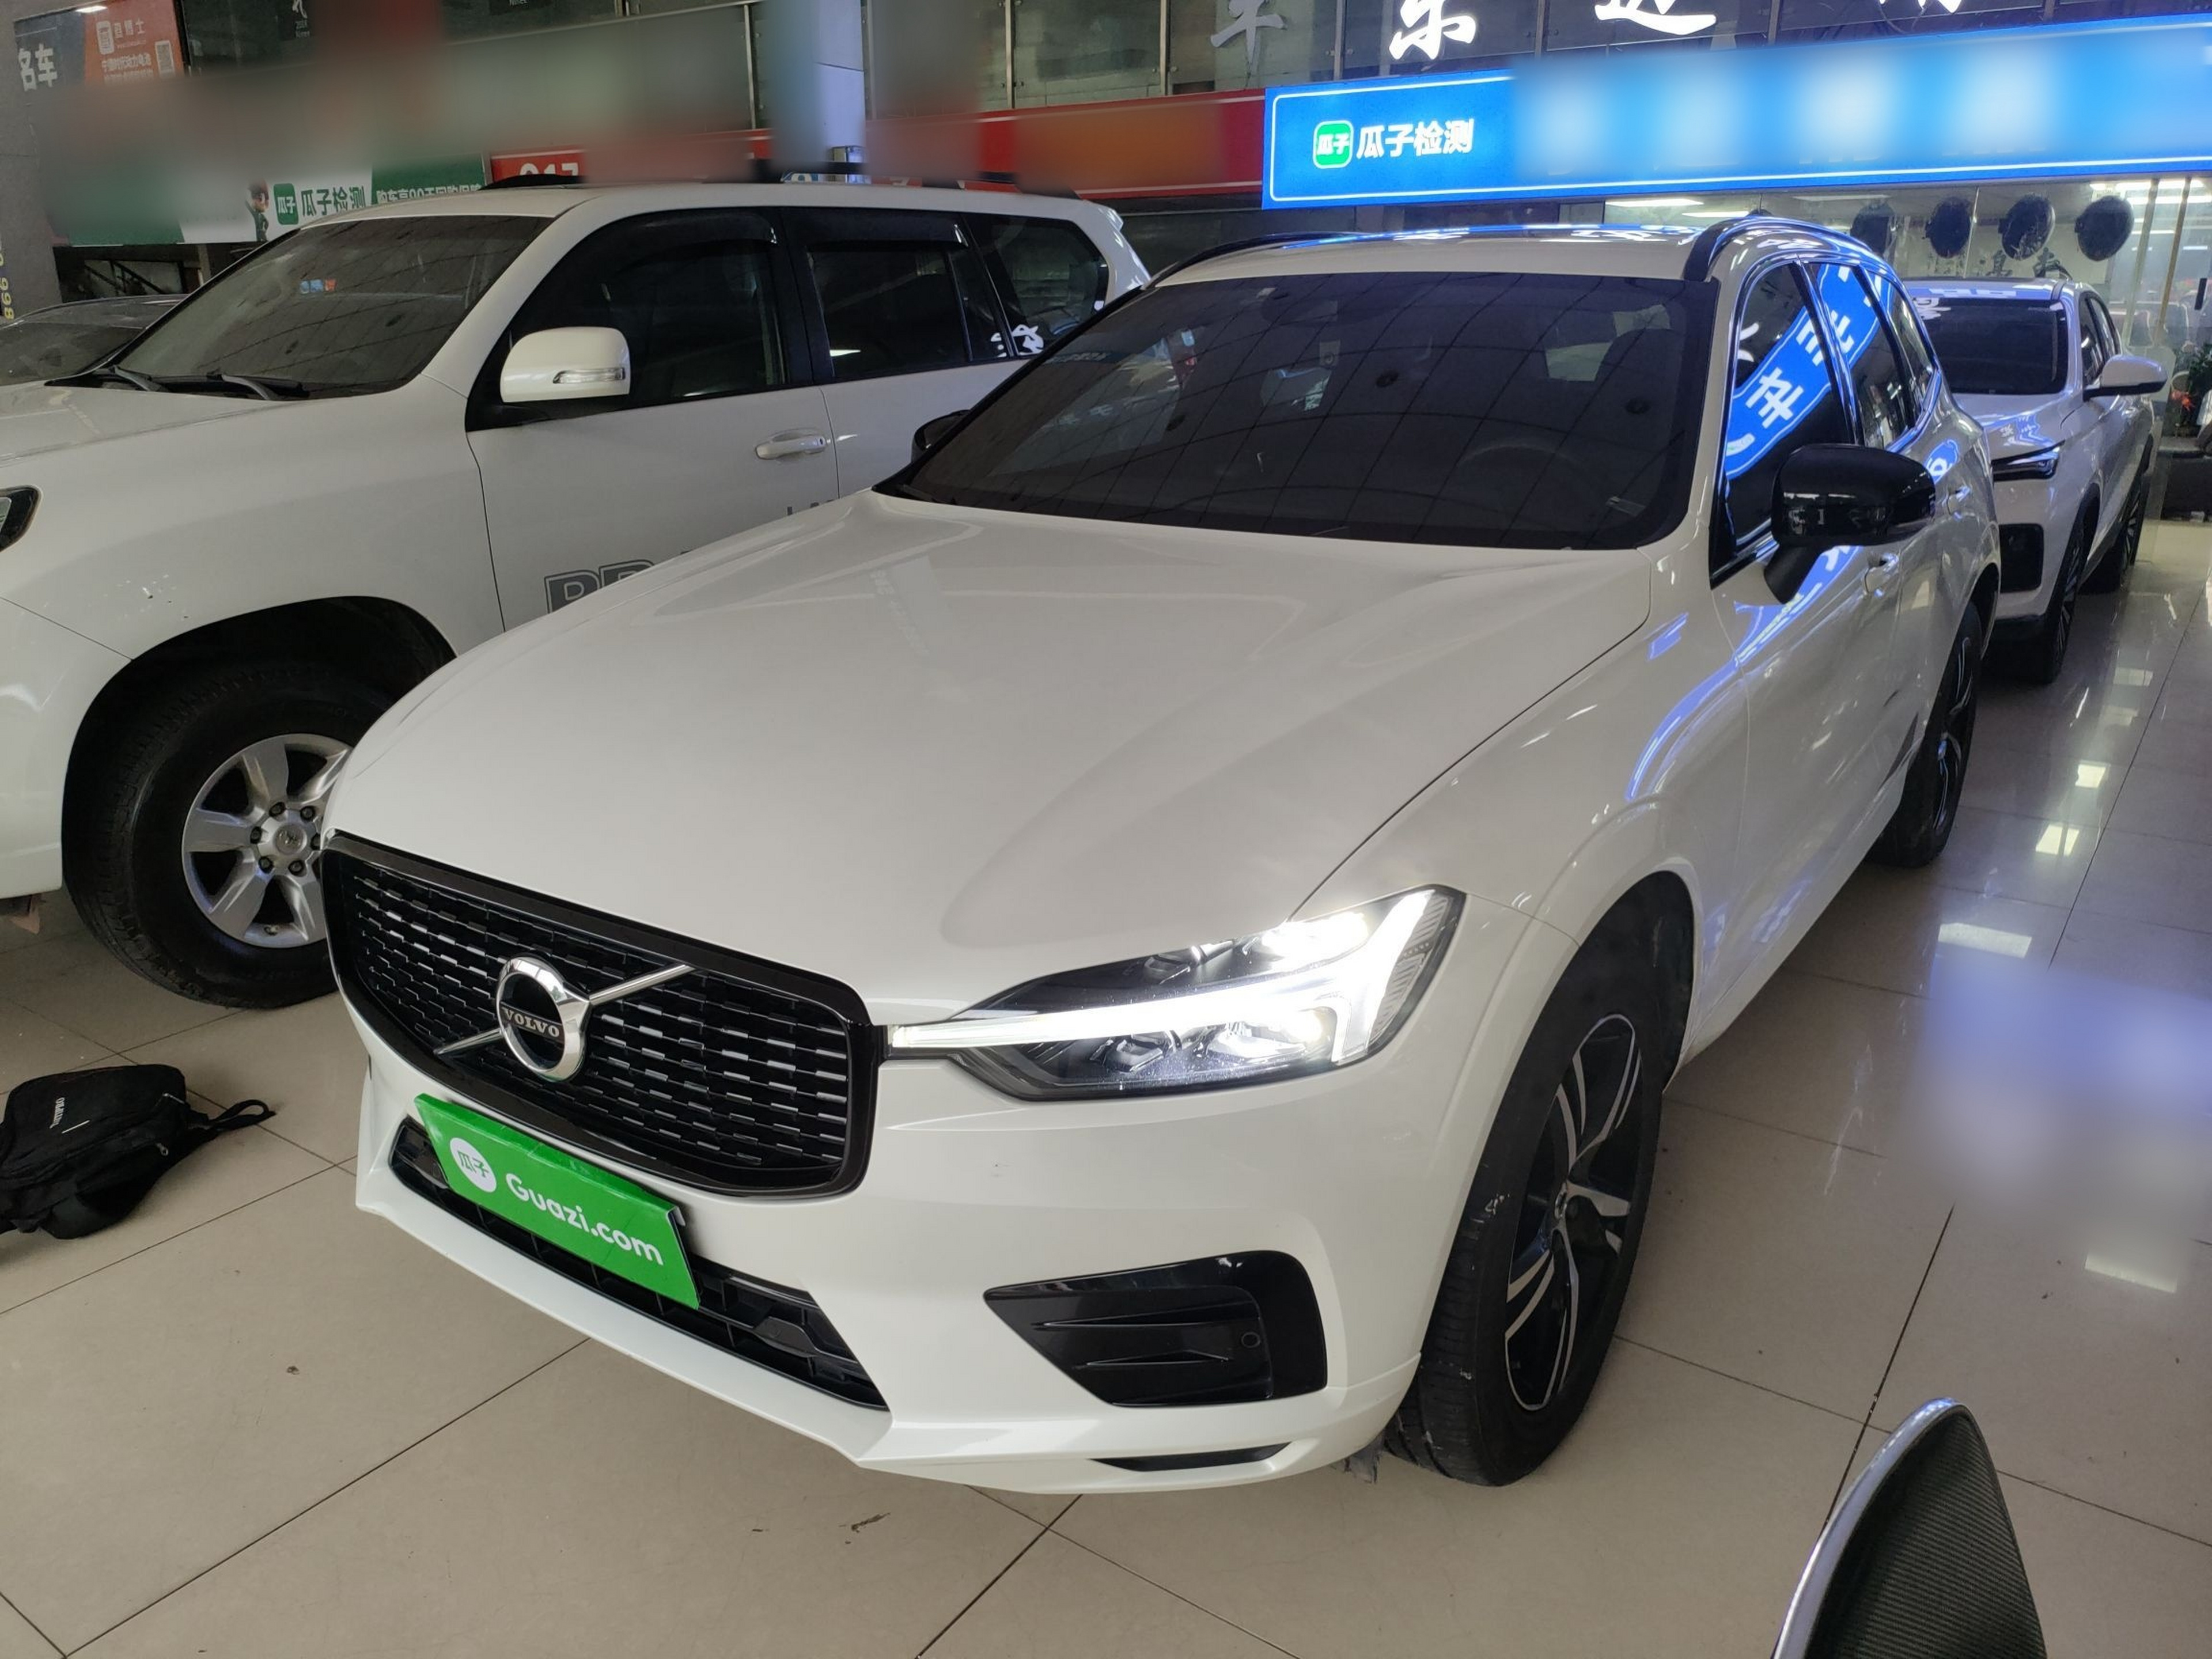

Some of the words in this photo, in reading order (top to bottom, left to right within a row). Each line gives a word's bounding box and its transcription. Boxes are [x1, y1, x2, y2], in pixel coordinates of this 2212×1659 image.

[1317, 133, 1350, 156] 瓜子
[1356, 118, 1475, 160] 瓜子检测
[276, 196, 296, 214] 瓜子
[301, 185, 366, 217] 瓜子检测
[501, 1006, 560, 1037] VOLVO
[457, 1150, 490, 1178] 瓜子
[505, 1173, 664, 1266] Guazi.com
